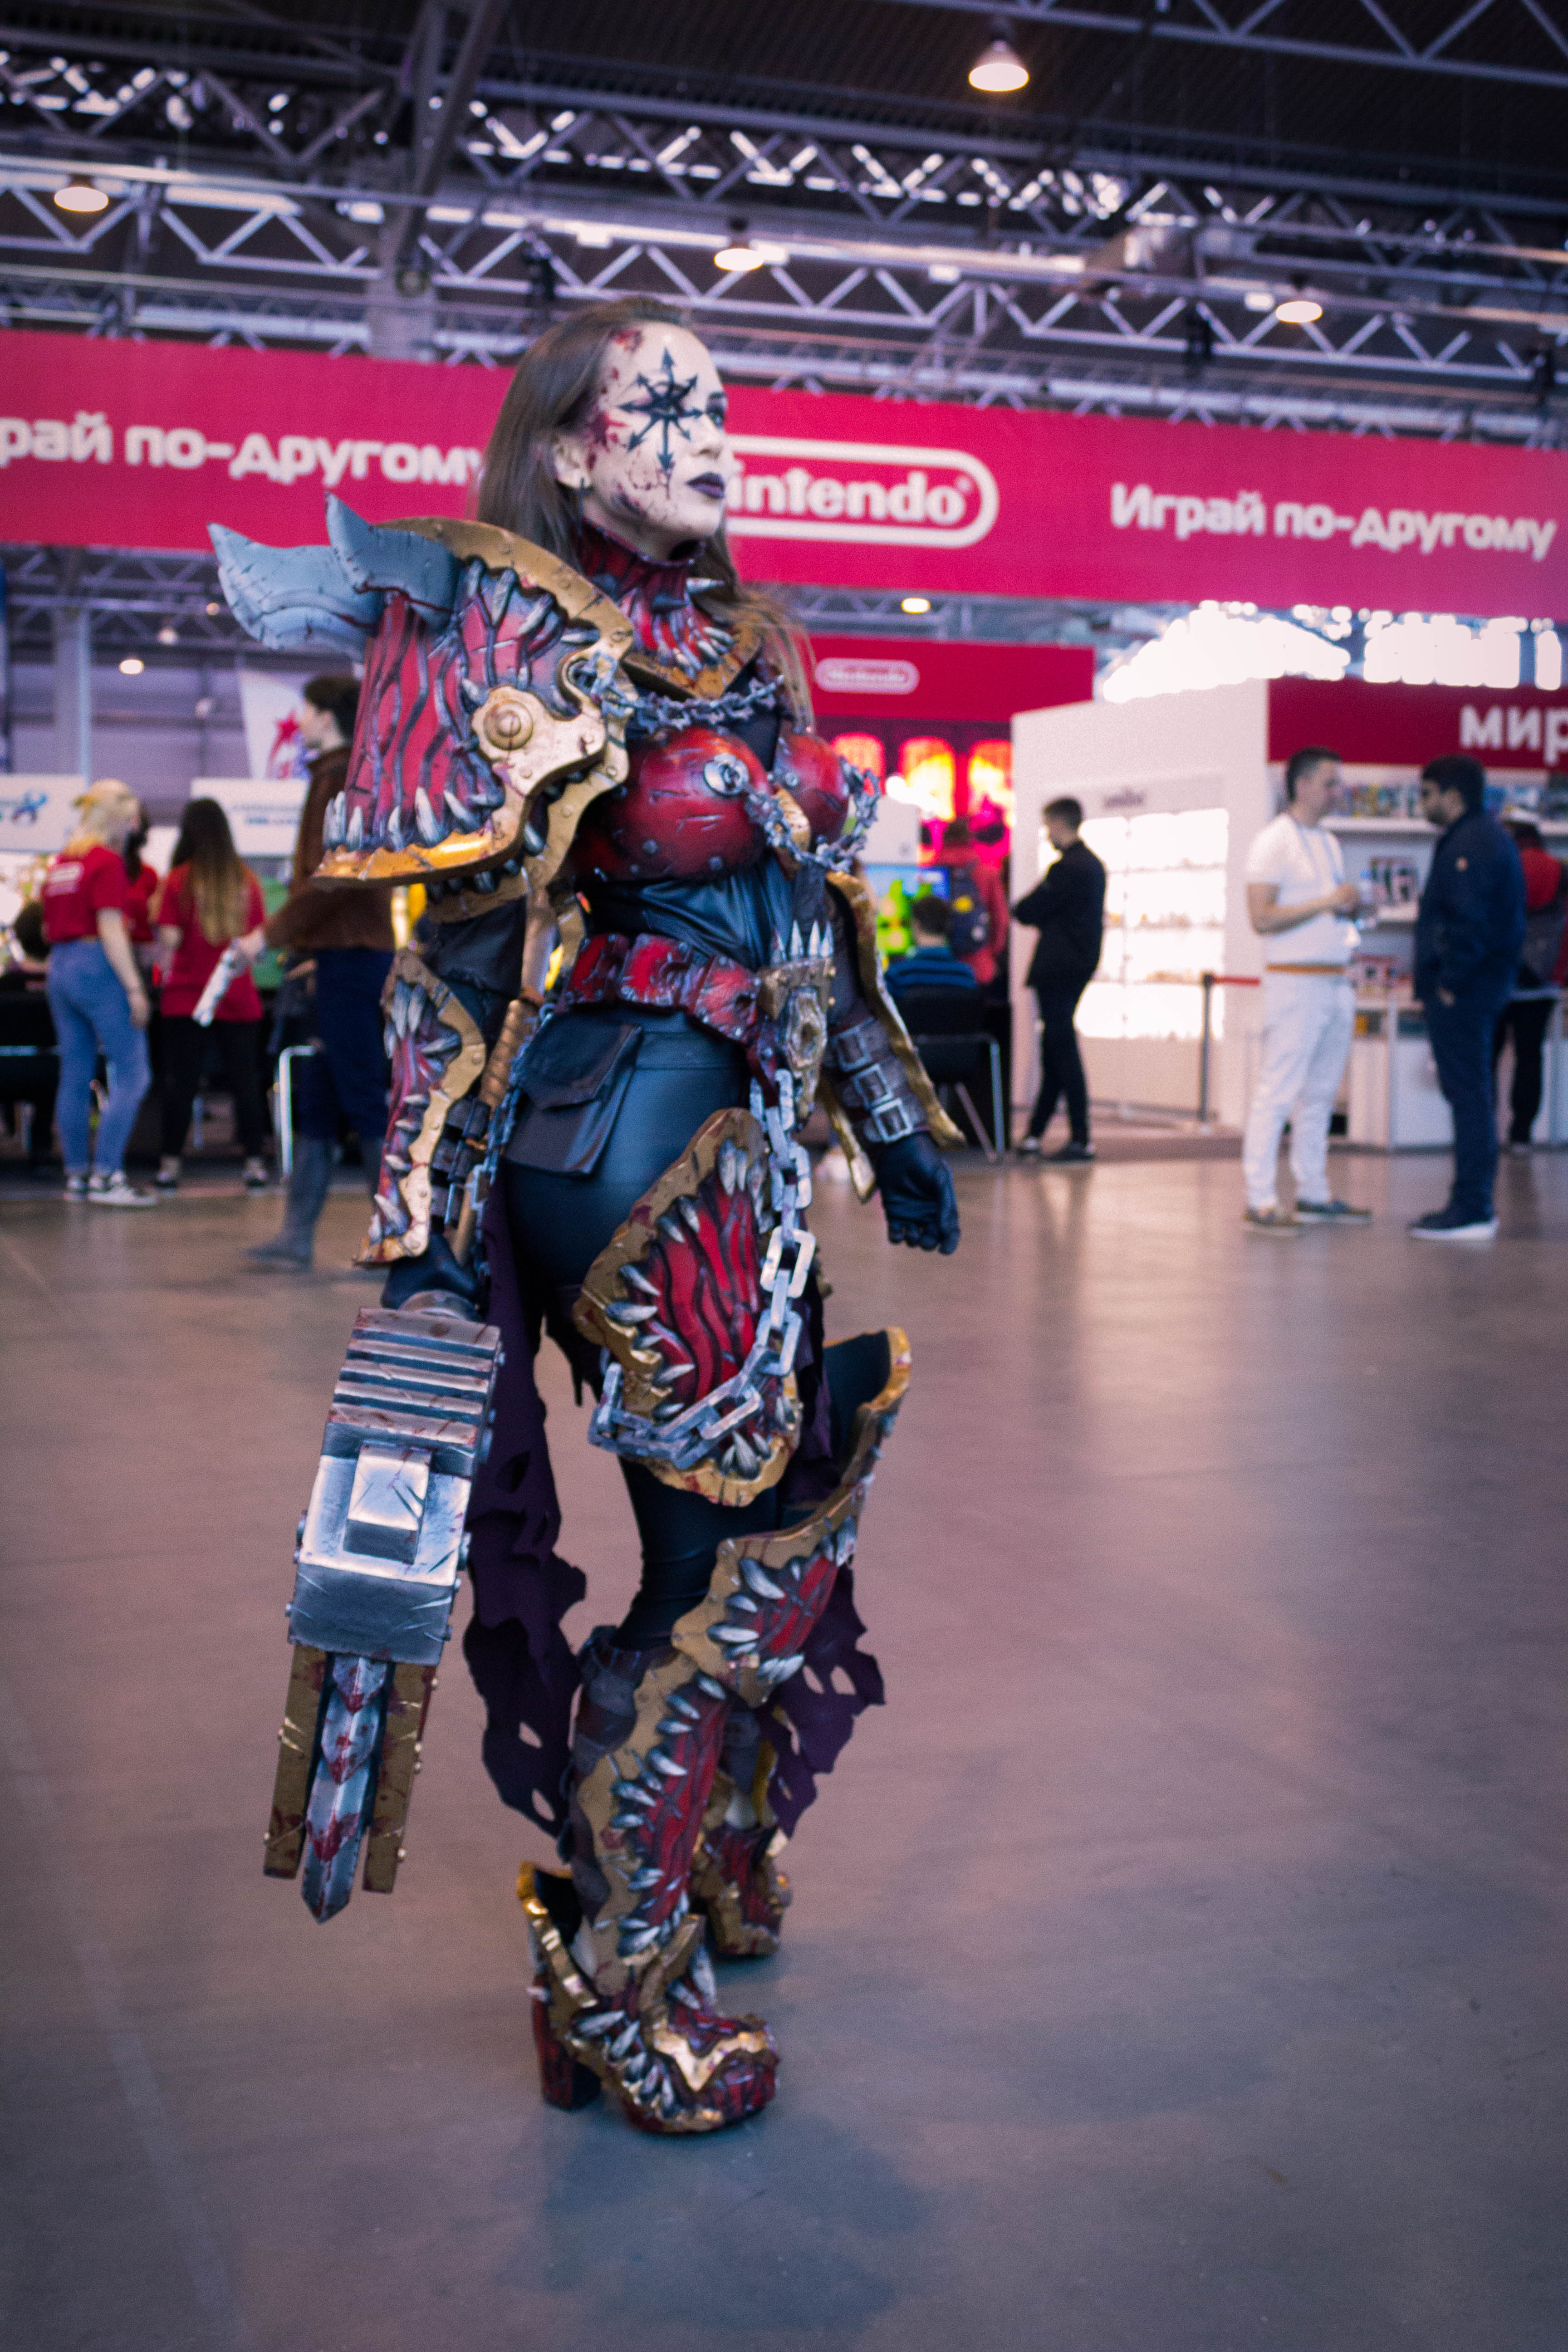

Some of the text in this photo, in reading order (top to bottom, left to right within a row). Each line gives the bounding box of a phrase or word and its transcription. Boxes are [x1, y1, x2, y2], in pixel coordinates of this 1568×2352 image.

[0, 411, 113, 467] рай
[726, 460, 965, 525] intendo
[1111, 483, 1557, 561] Играй по-другому
